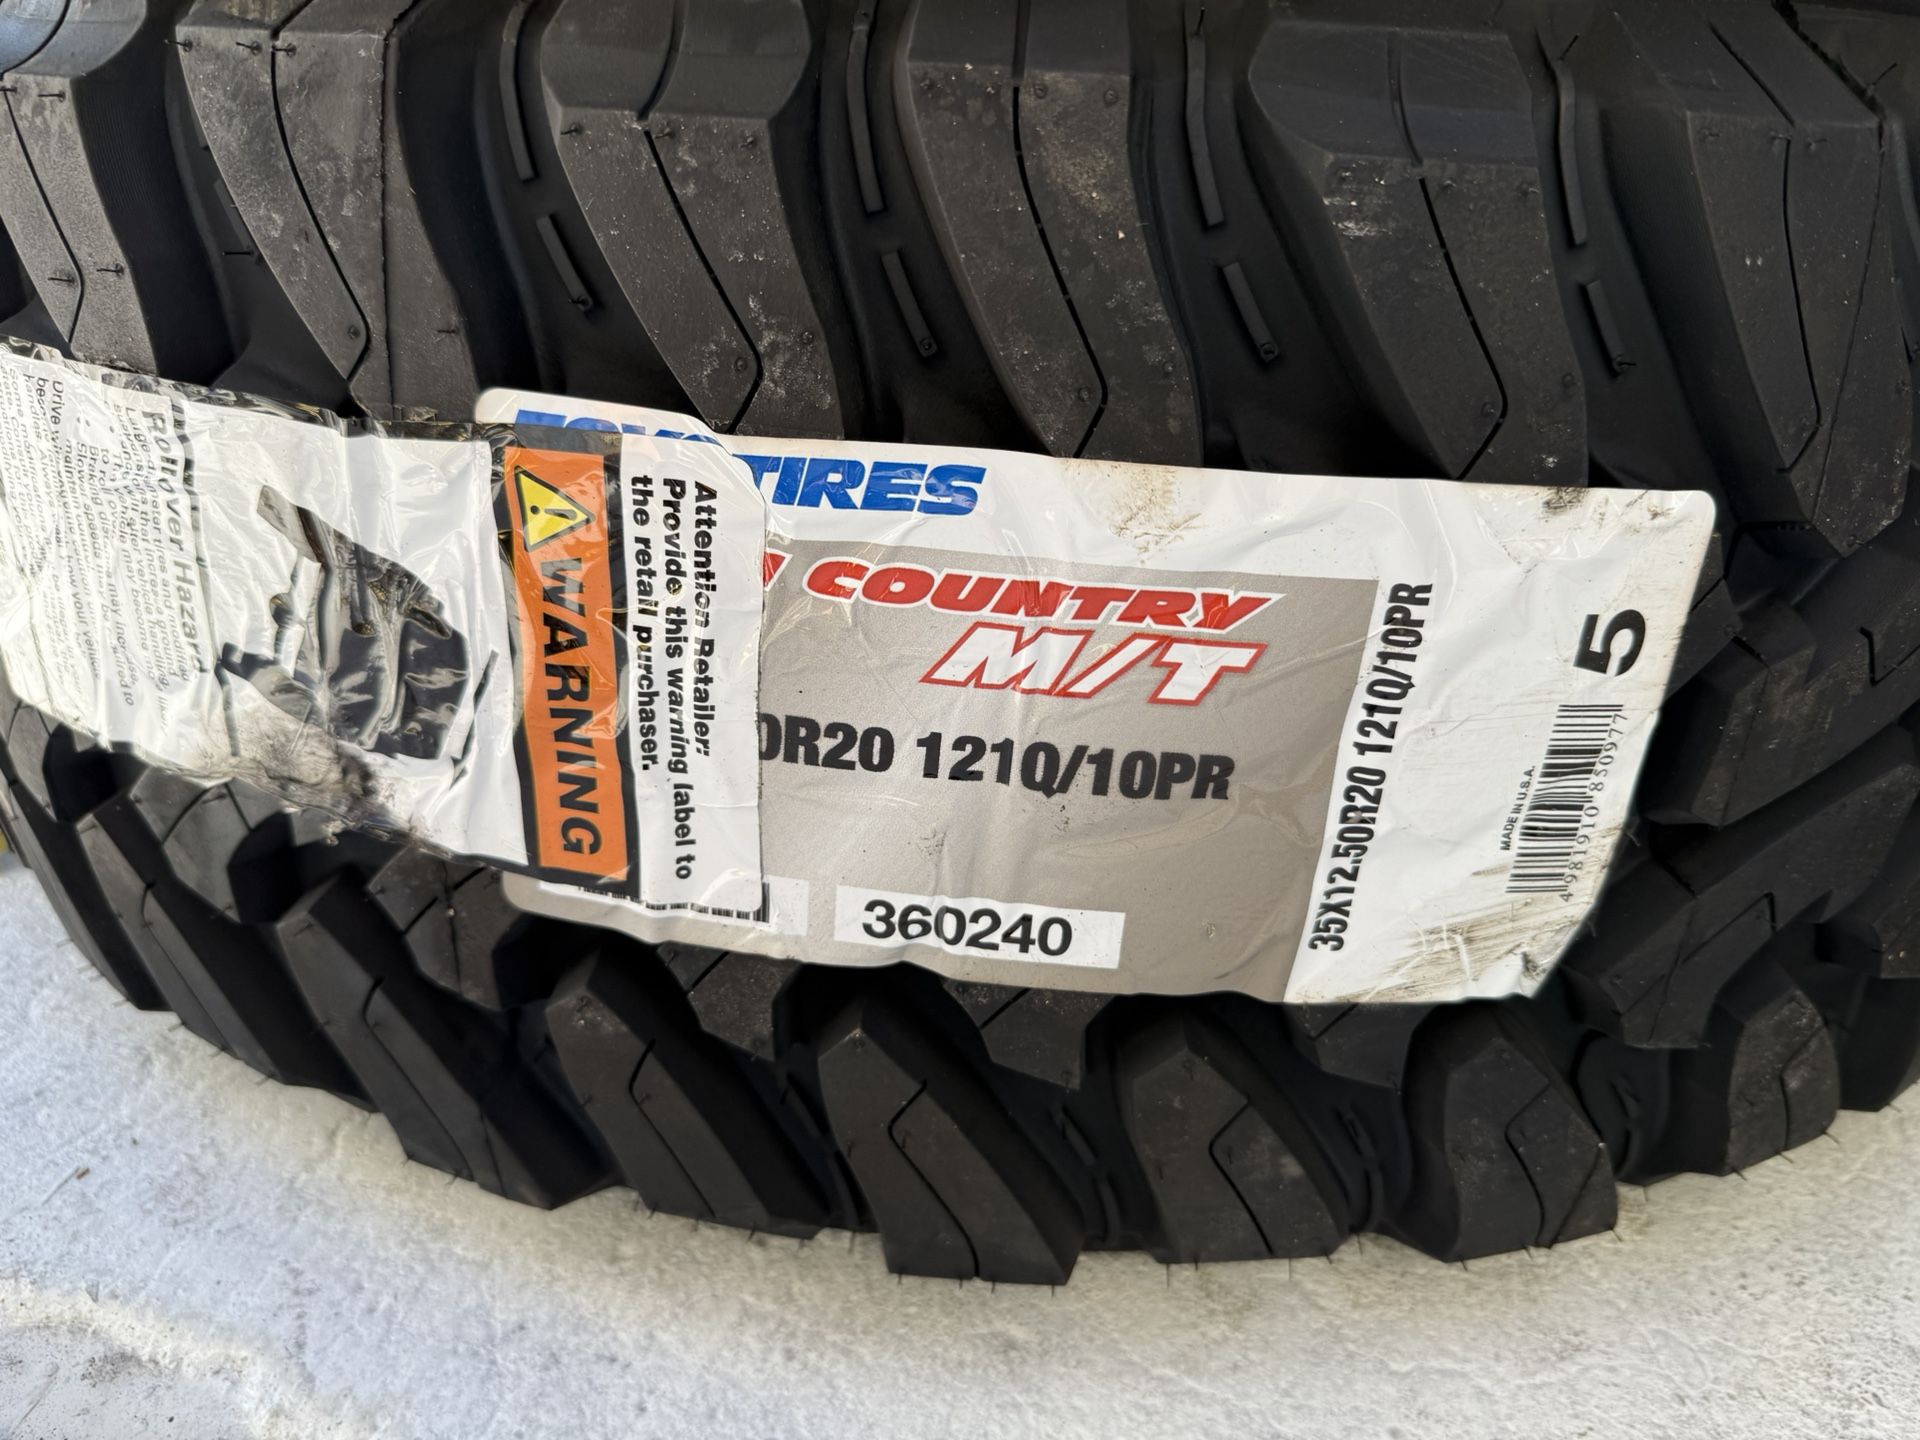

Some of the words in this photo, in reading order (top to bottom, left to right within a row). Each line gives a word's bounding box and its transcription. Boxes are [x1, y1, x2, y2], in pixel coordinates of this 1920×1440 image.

[50, 380, 65, 425] Drive
[98, 469, 115, 496] roll
[100, 448, 111, 465] to
[734, 454, 987, 517] TIRES
[88, 445, 105, 506] Braking
[107, 583, 123, 616] may
[631, 475, 653, 527] the
[141, 410, 184, 552] Rollover
[173, 559, 211, 675] Hazard
[663, 478, 687, 595] Provide
[694, 480, 718, 629] Attention
[83, 503, 103, 560] speeds
[123, 691, 135, 706] to
[120, 549, 138, 584] may
[131, 588, 153, 651] become
[136, 560, 154, 615] vehicle
[160, 578, 175, 610] and
[633, 536, 659, 617] retail
[804, 557, 1283, 632] COUNTRY
[155, 619, 180, 677] ground
[664, 605, 687, 659] this
[919, 621, 1268, 706] M/T
[1573, 609, 1646, 677] 5
[541, 557, 602, 856] WARNING
[631, 624, 660, 771] purchaser.
[663, 667, 690, 774] warning
[694, 639, 718, 756] Retailer:
[915, 732, 1236, 801] 121Q/10PR
[1308, 766, 1387, 951] 35X12.50R20
[1353, 583, 1433, 756] 121Q/10PR
[1515, 765, 1536, 801] U.S.A.
[673, 783, 697, 846] label
[1500, 816, 1519, 851] MADE
[1510, 803, 1525, 815] IN
[675, 854, 694, 880] to
[861, 899, 1074, 956] 360240
